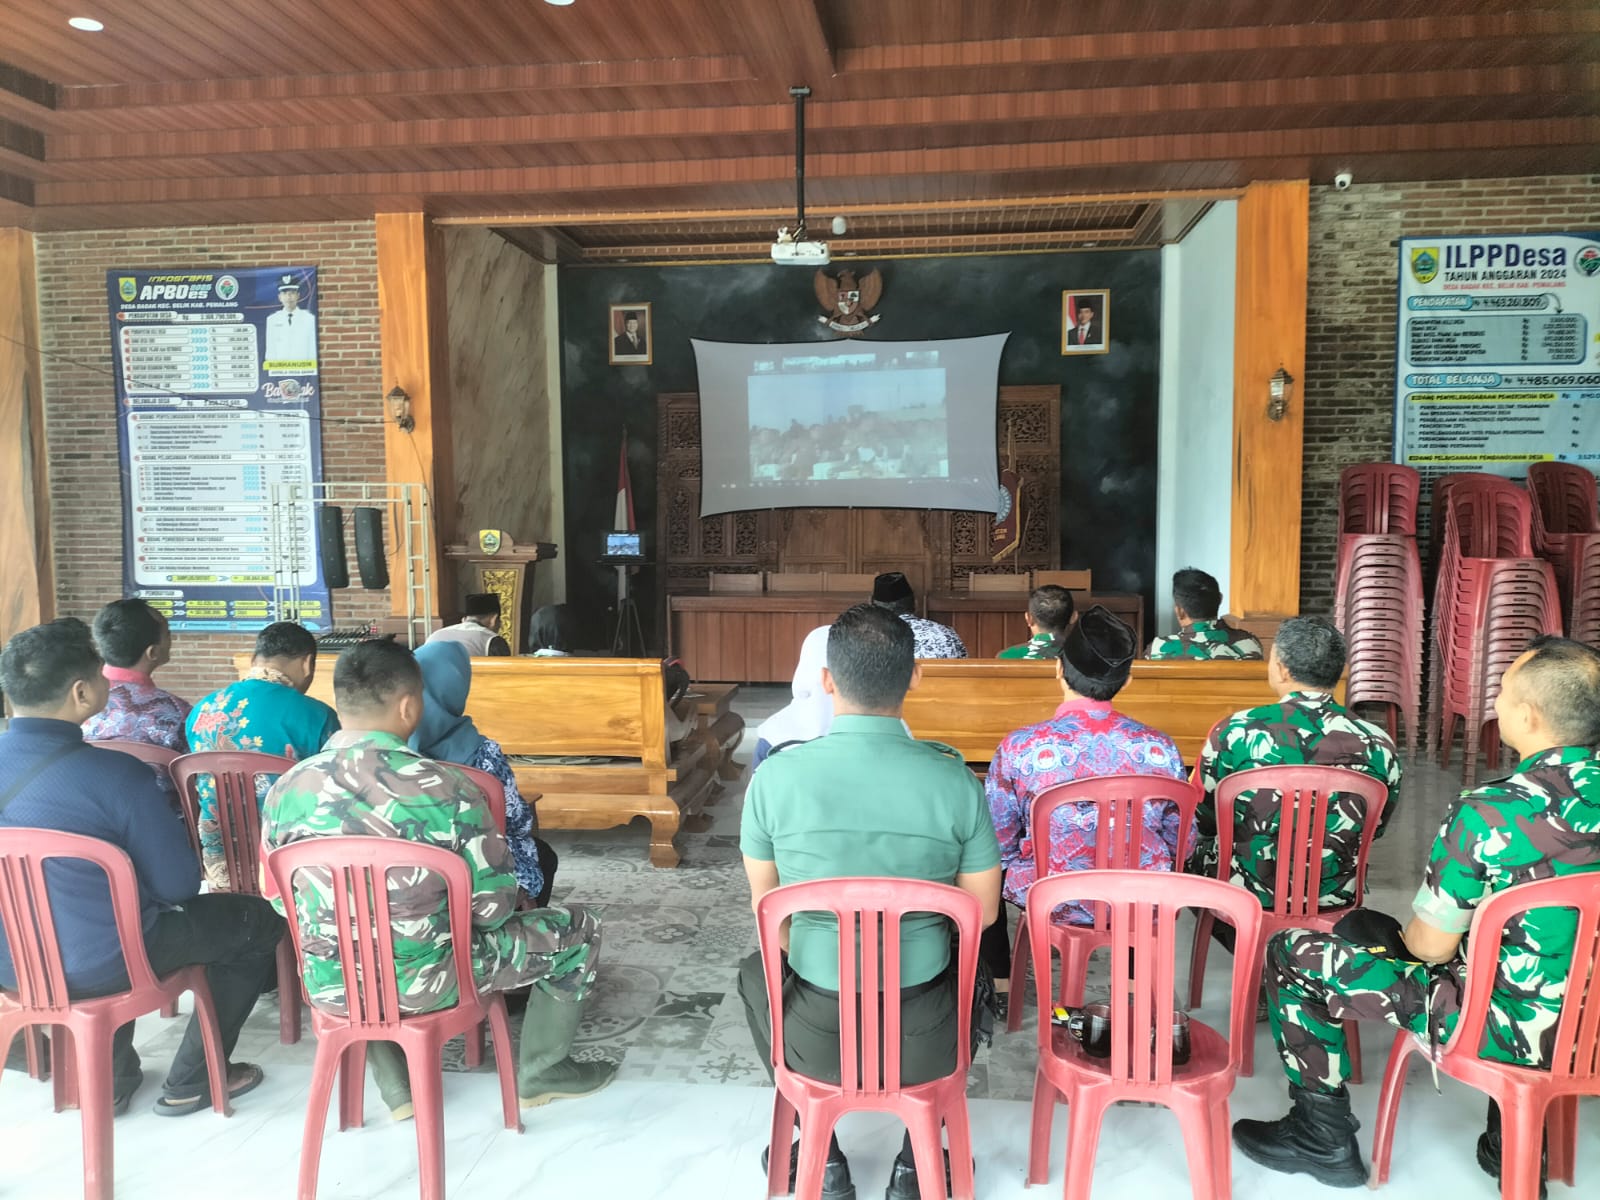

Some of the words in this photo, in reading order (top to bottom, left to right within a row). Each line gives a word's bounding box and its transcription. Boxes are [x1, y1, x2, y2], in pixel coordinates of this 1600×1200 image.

[1446, 244, 1567, 268] ILPPDesa
[1444, 271, 1478, 281] TAHUN
[1481, 270, 1537, 280] ANGGARAN
[1540, 269, 1566, 279] 2024
[1412, 375, 1442, 384] TOTAL
[1446, 375, 1495, 384] BELANJA
